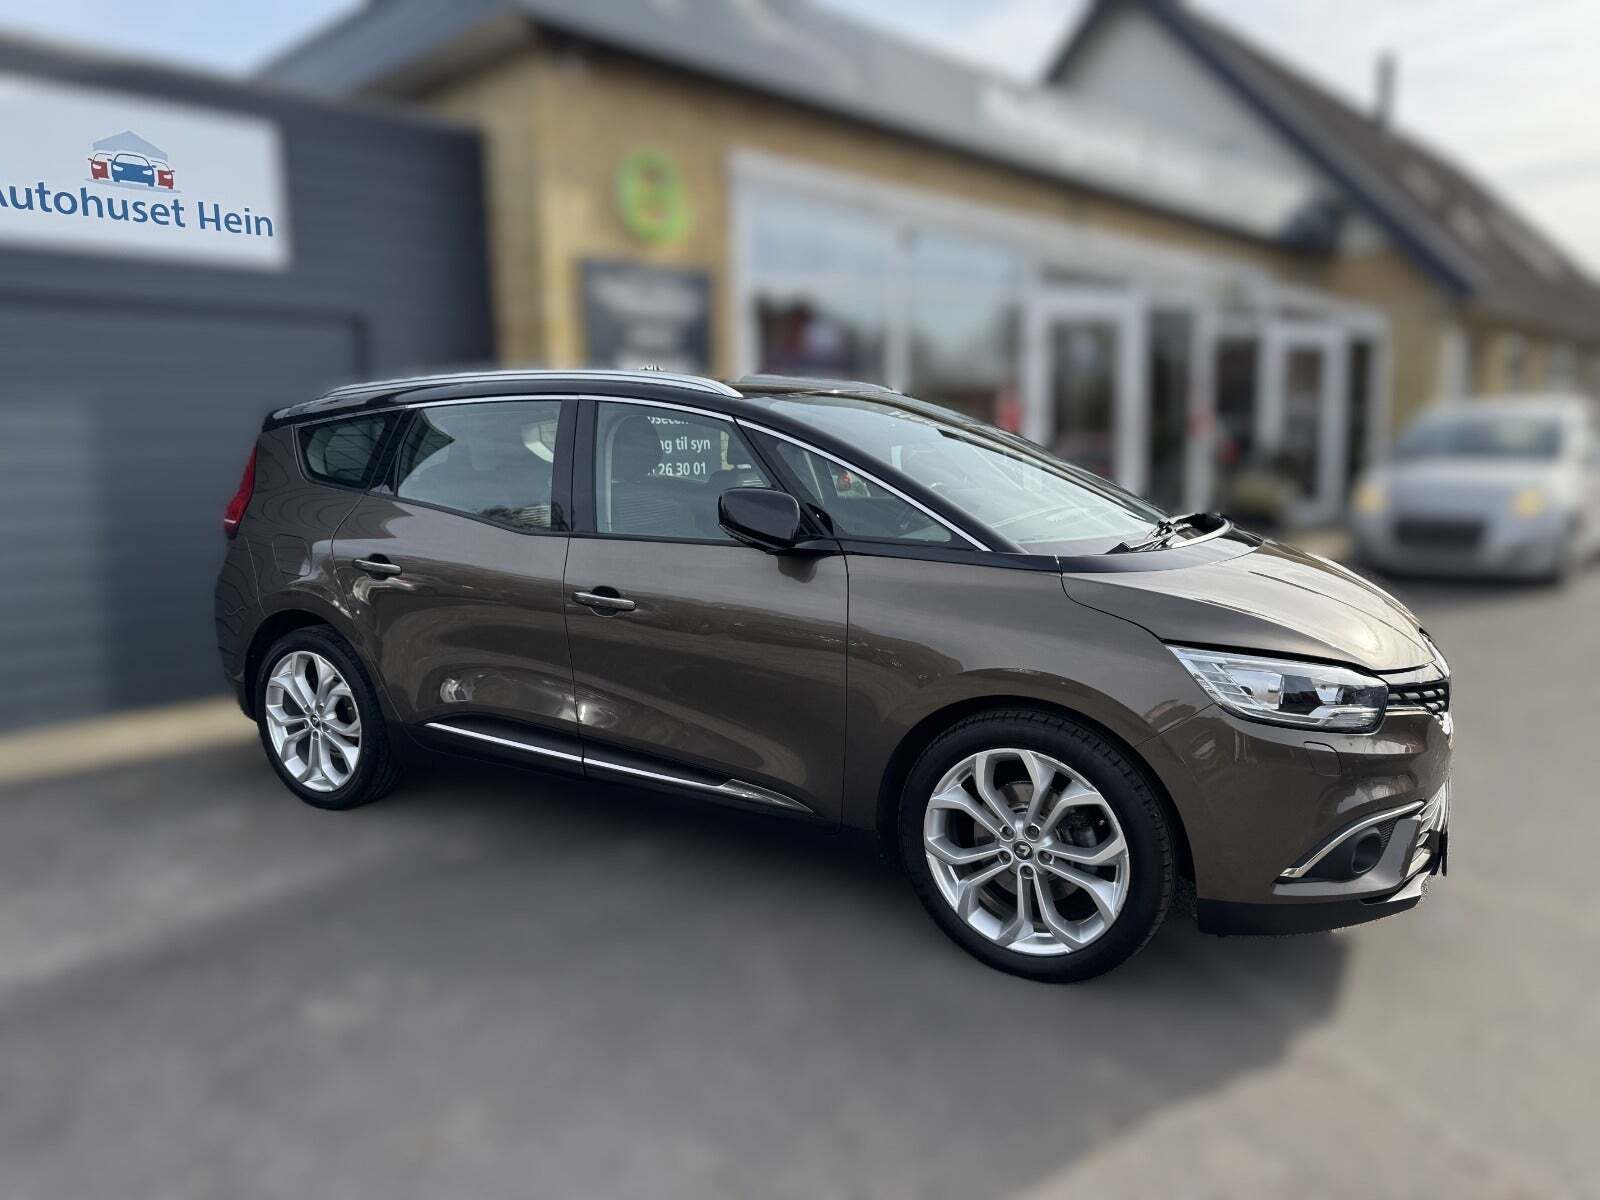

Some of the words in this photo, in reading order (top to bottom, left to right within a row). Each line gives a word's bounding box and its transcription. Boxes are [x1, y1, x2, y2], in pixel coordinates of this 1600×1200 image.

[198, 201, 273, 237] Hein
[675, 436, 688, 450] til
[690, 439, 711, 453] syn
[658, 462, 673, 476] 26
[676, 462, 691, 476] 30
[693, 461, 706, 475] 01
